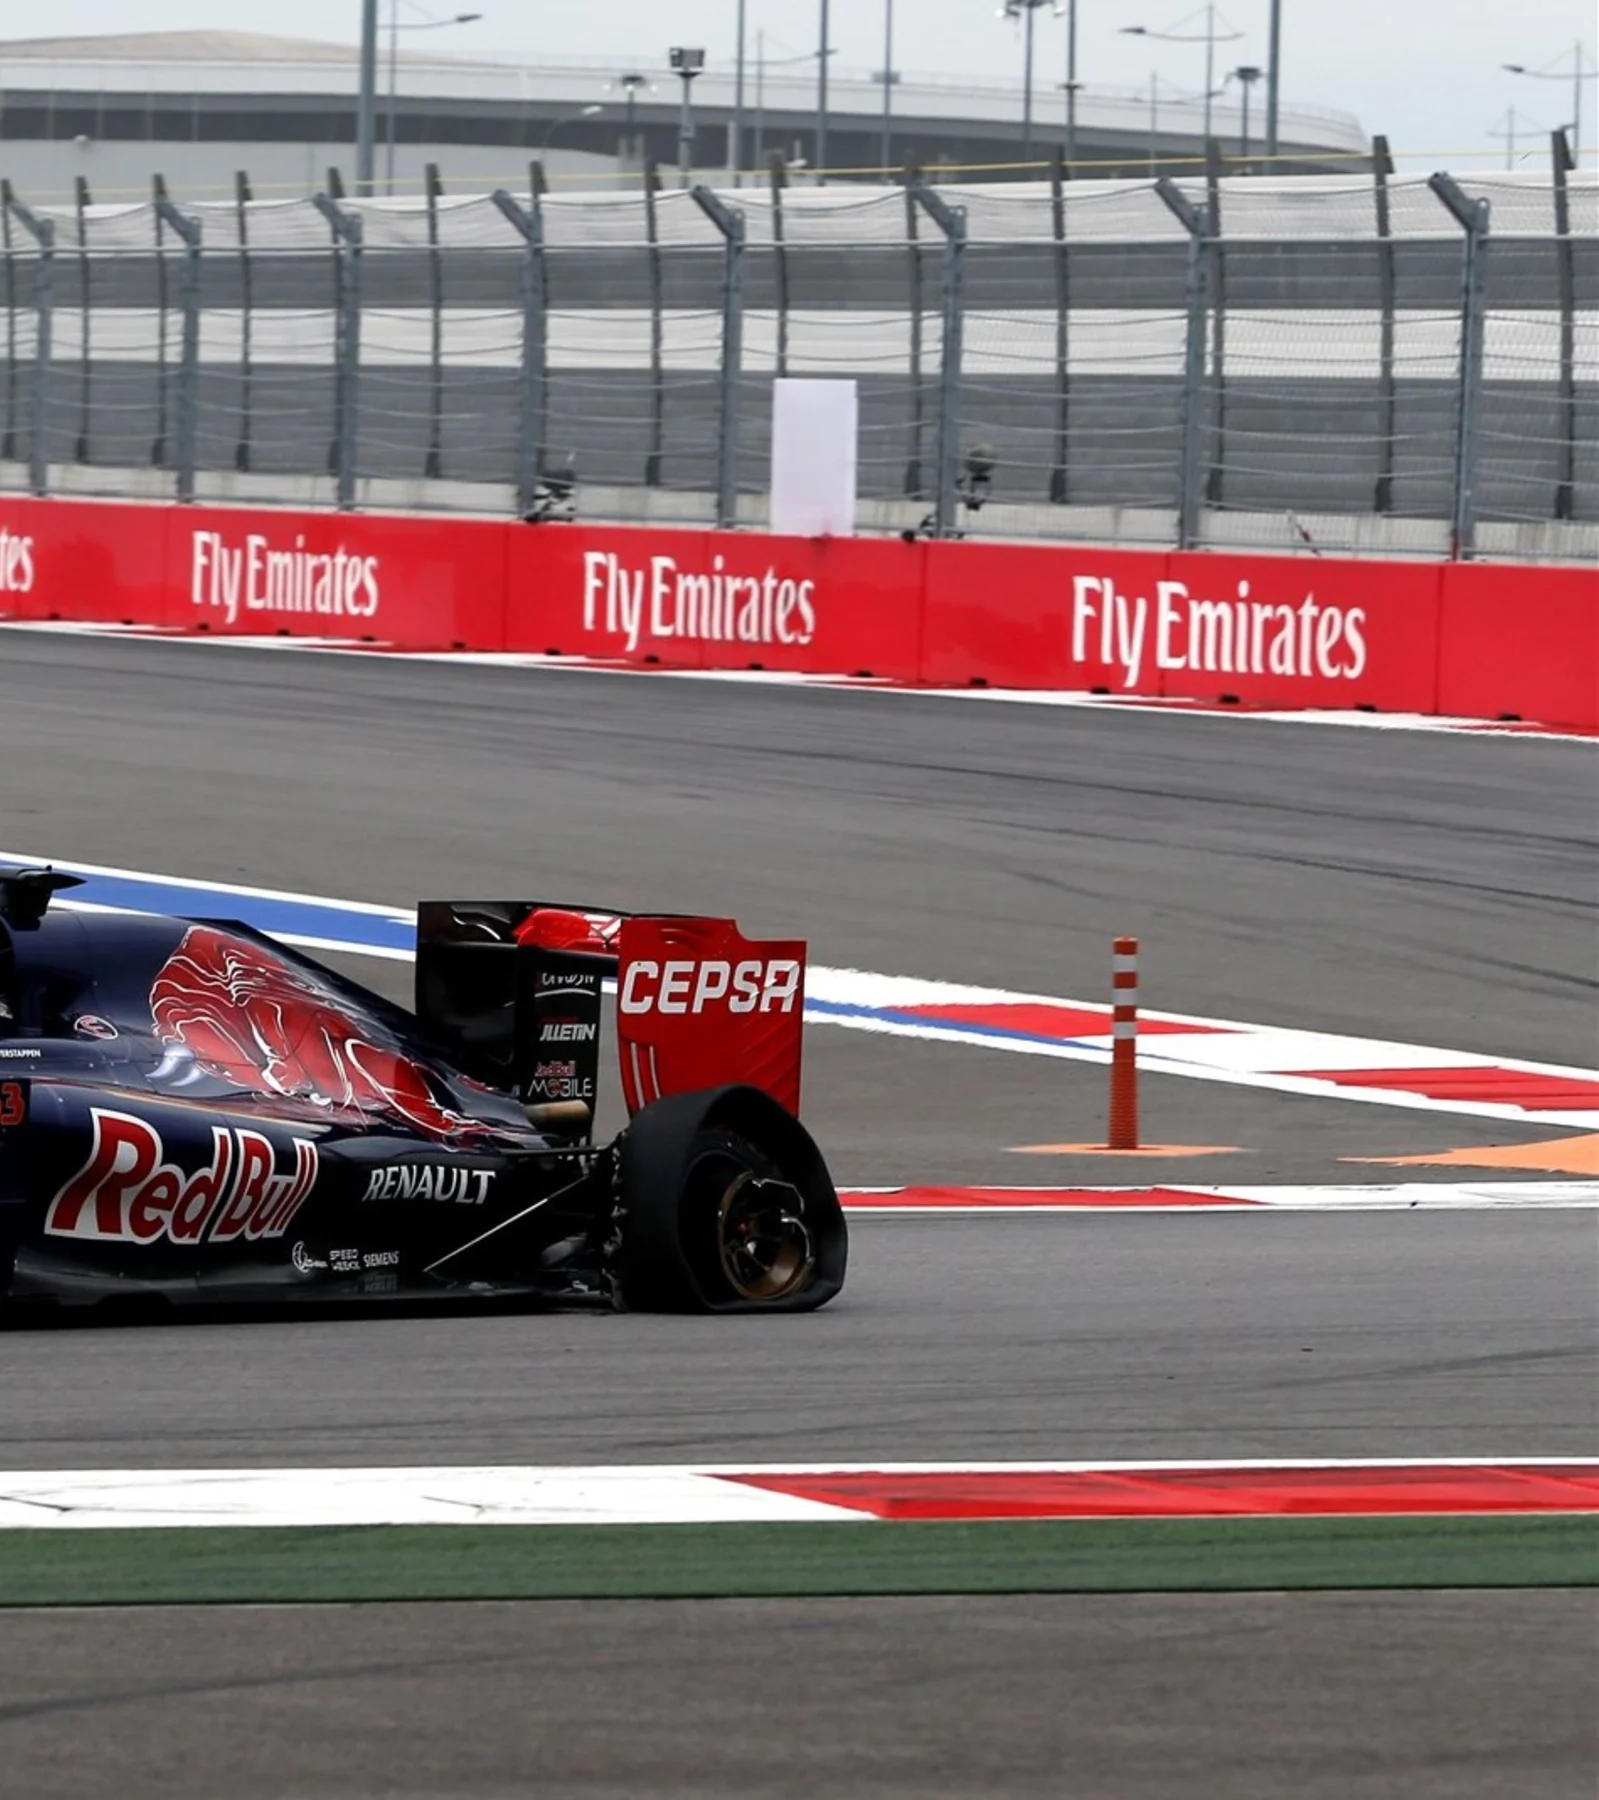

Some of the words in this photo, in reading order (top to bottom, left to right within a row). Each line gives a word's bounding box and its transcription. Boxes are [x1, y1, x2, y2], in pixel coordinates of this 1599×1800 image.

[192, 530, 242, 624] Fly
[246, 533, 379, 617] Emirates
[584, 551, 645, 652] Fly
[651, 554, 816, 645] Emirates
[1072, 575, 1147, 688] Fly
[1156, 580, 1367, 680] Emirates
[620, 960, 800, 1014] CEPSA
[44, 1107, 232, 1245] Red
[208, 1127, 319, 1243] Bull
[361, 1164, 497, 1205] RENAULT
[363, 1250, 399, 1267] SIEMENS
